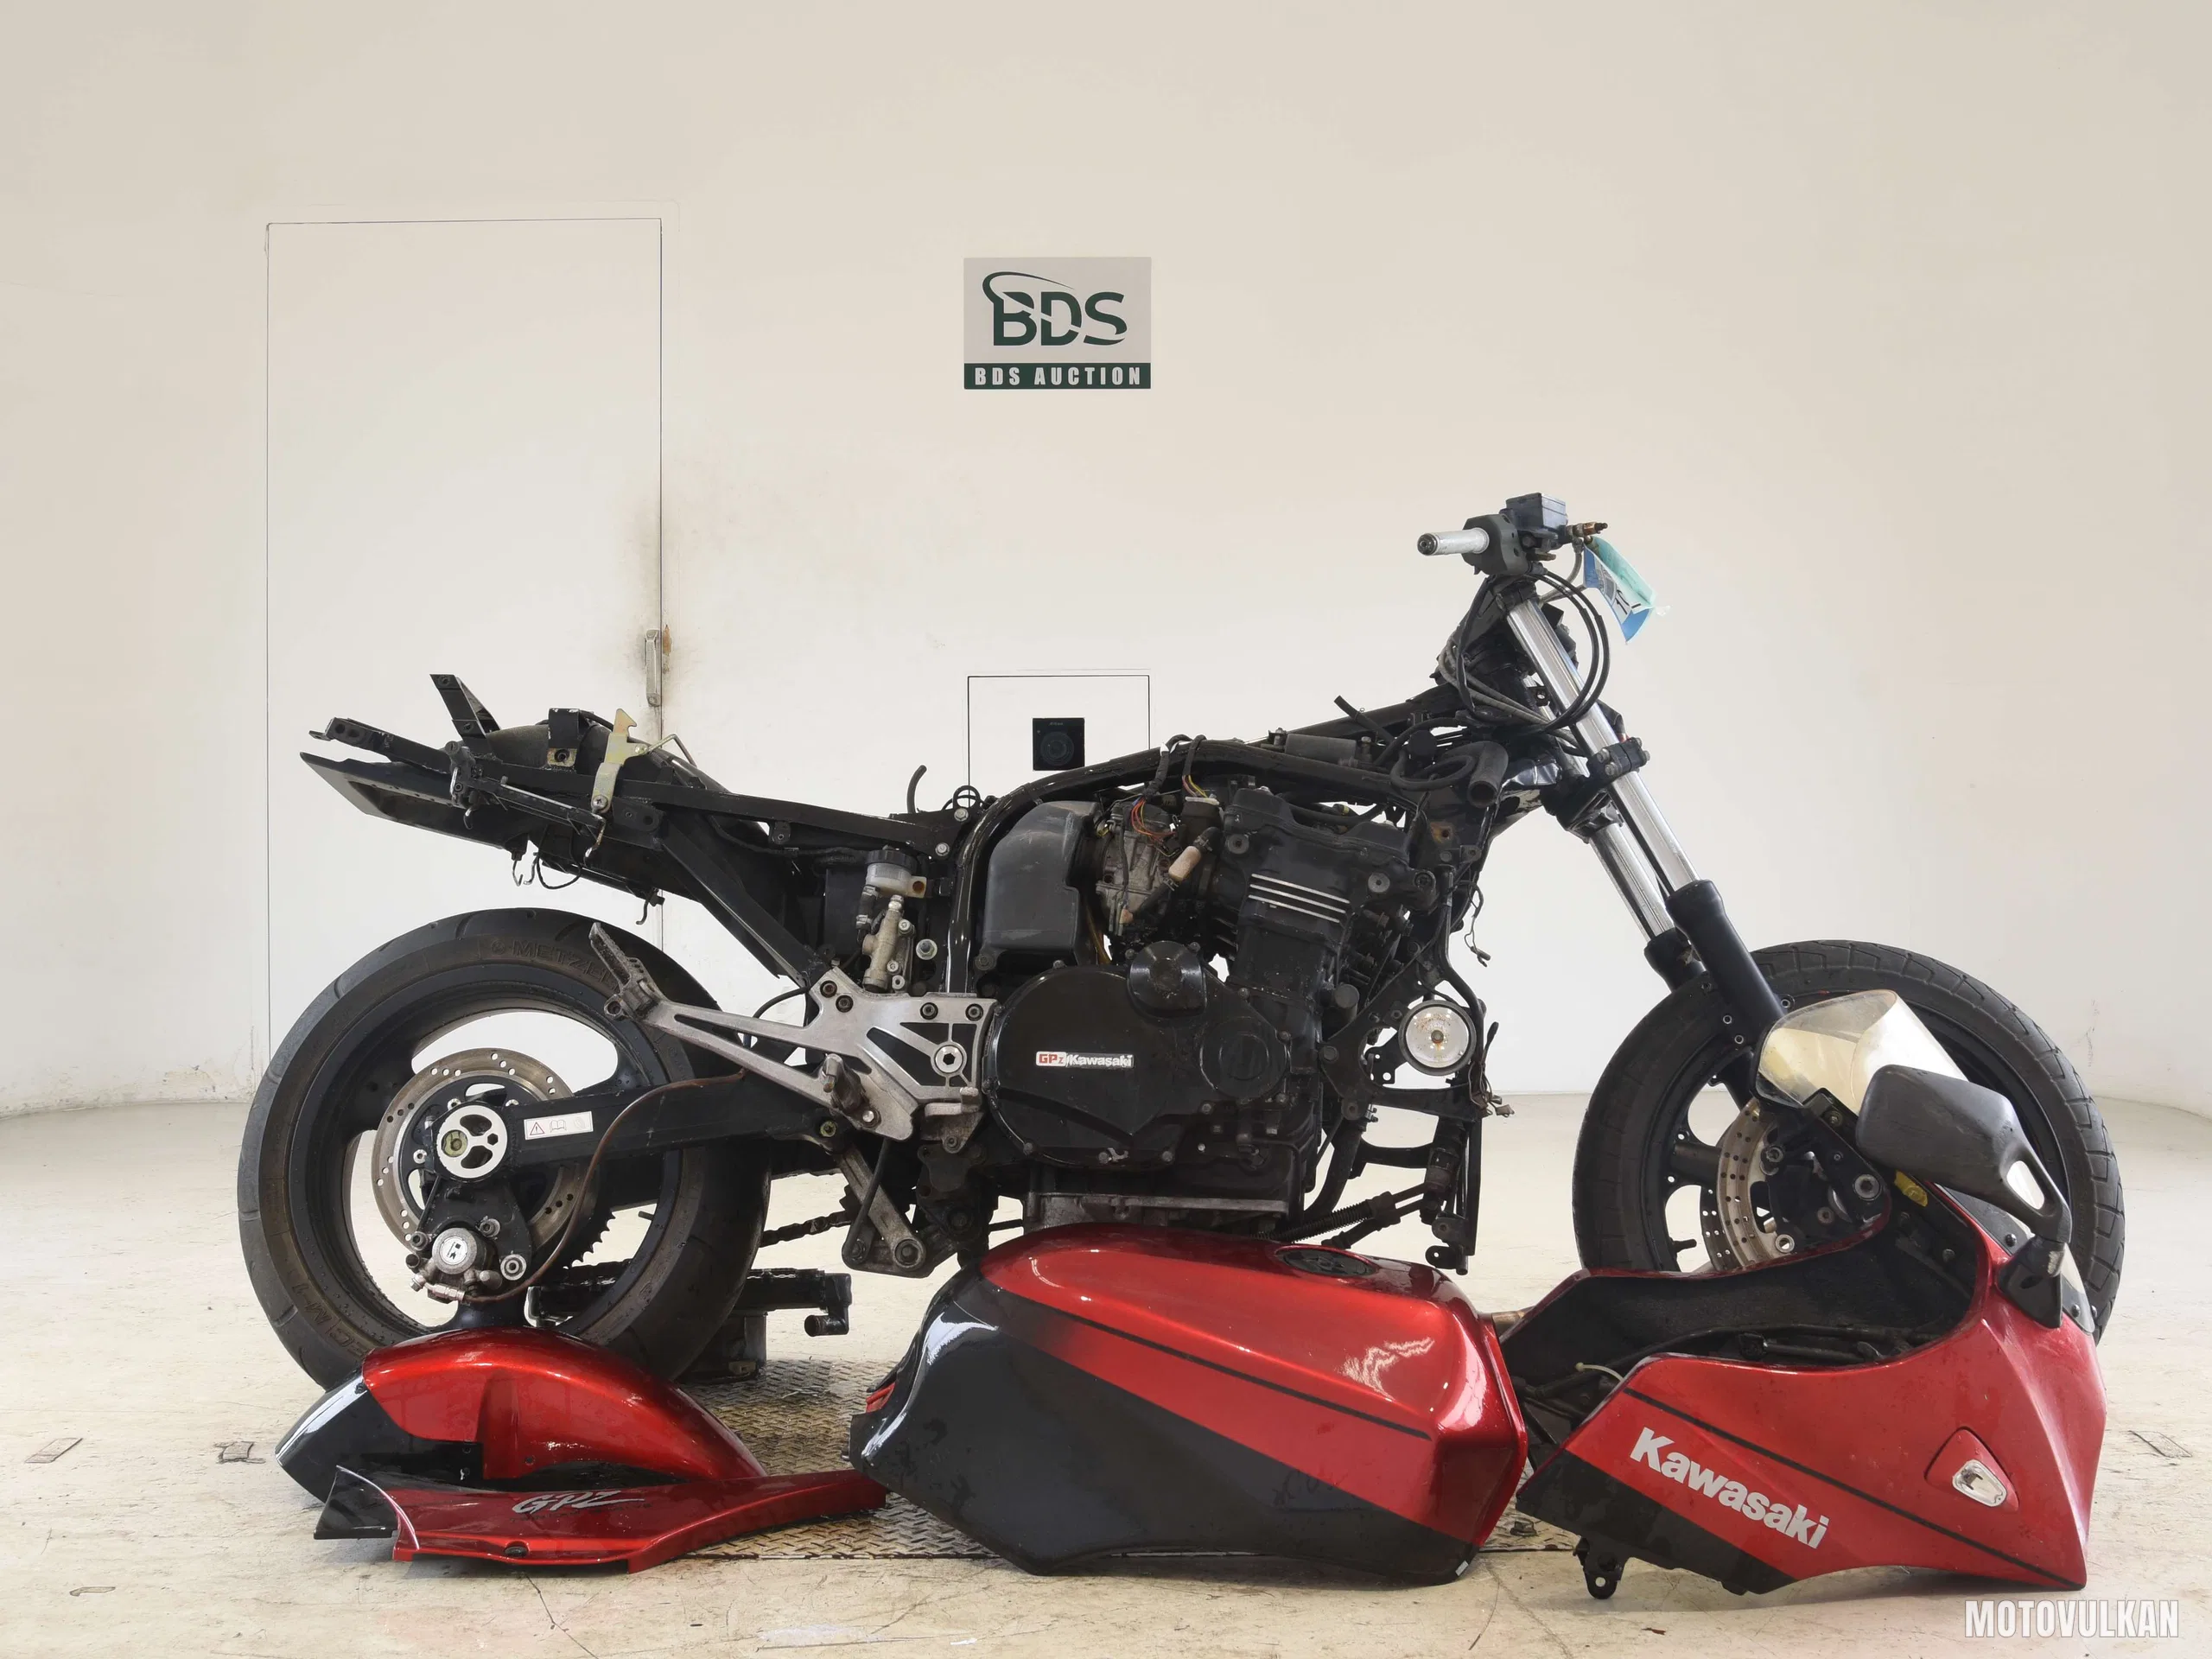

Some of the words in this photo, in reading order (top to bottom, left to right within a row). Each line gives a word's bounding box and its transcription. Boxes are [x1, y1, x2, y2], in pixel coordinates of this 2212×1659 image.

[983, 271, 1127, 346] BDS
[975, 367, 1020, 385] BDS
[1034, 367, 1141, 385] AUCTION
[1068, 1054, 1133, 1066] Kawasaki
[1630, 1427, 1830, 1549] Kawasaki
[512, 1491, 645, 1514] GPZ
